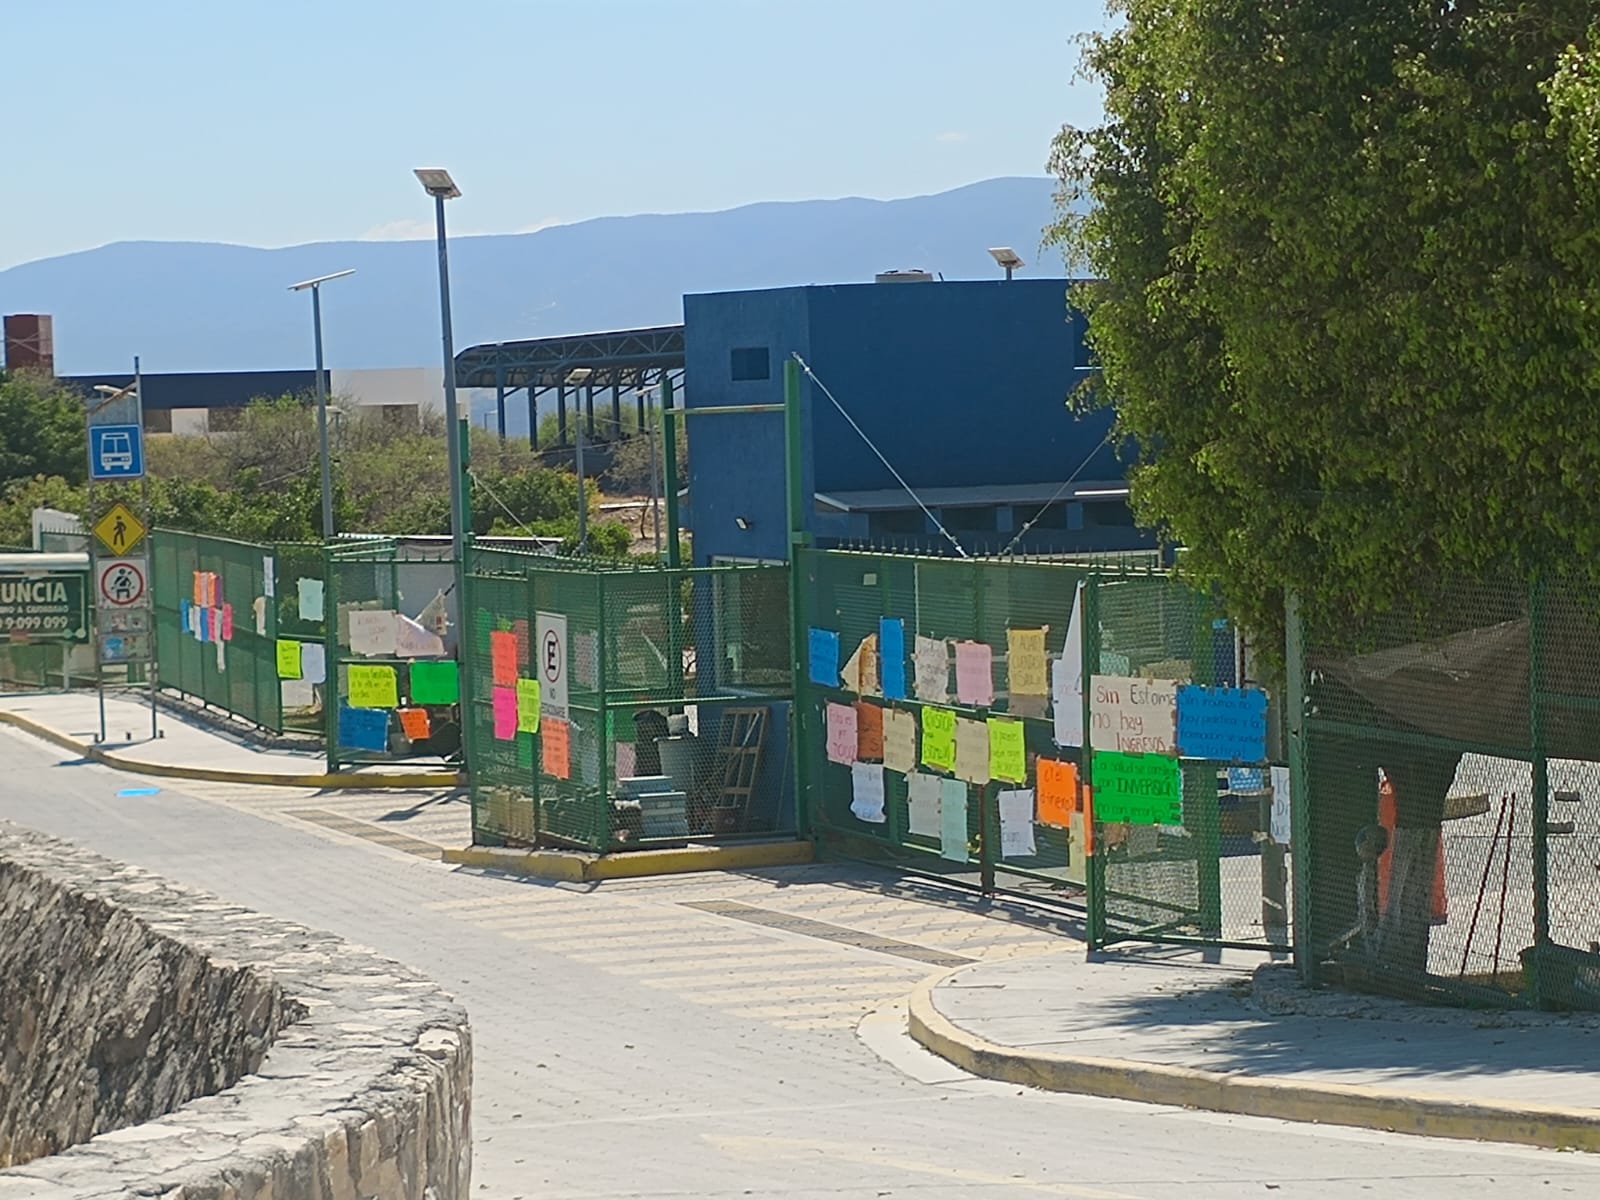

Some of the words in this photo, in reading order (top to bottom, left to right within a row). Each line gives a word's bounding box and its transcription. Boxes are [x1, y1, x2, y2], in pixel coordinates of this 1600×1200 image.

[44, 616, 69, 629] 099
[547, 640, 557, 671] E
[1096, 685, 1120, 705] Sin
[1092, 712, 1112, 729] no
[1120, 709, 1144, 736] hay
[1111, 759, 1134, 774] salud
[1117, 776, 1179, 798] INVERSIÓN
